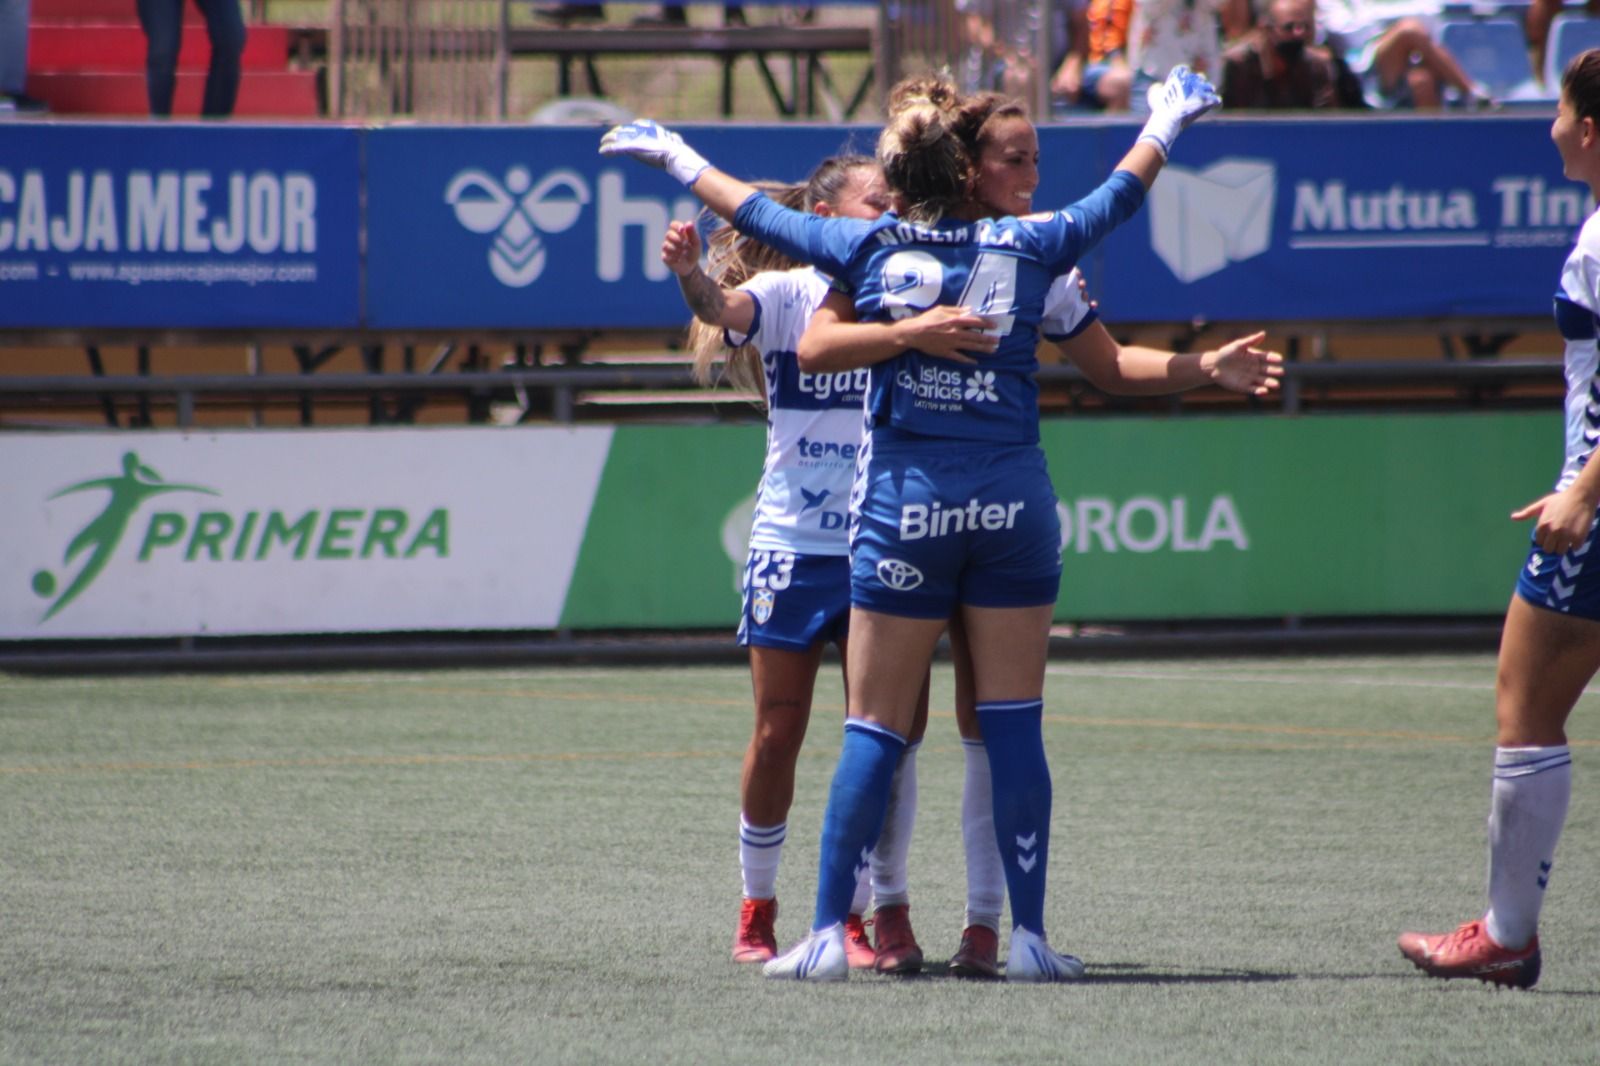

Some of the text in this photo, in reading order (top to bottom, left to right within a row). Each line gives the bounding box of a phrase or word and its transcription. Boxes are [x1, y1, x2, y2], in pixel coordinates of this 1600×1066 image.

[127, 170, 318, 253] MEJOR
[1292, 181, 1478, 231] Mutua
[881, 251, 1018, 346] 24
[797, 436, 862, 459] tene
[137, 508, 451, 562] PRIMERA
[899, 498, 1025, 541] Binter
[751, 550, 796, 591] 23
